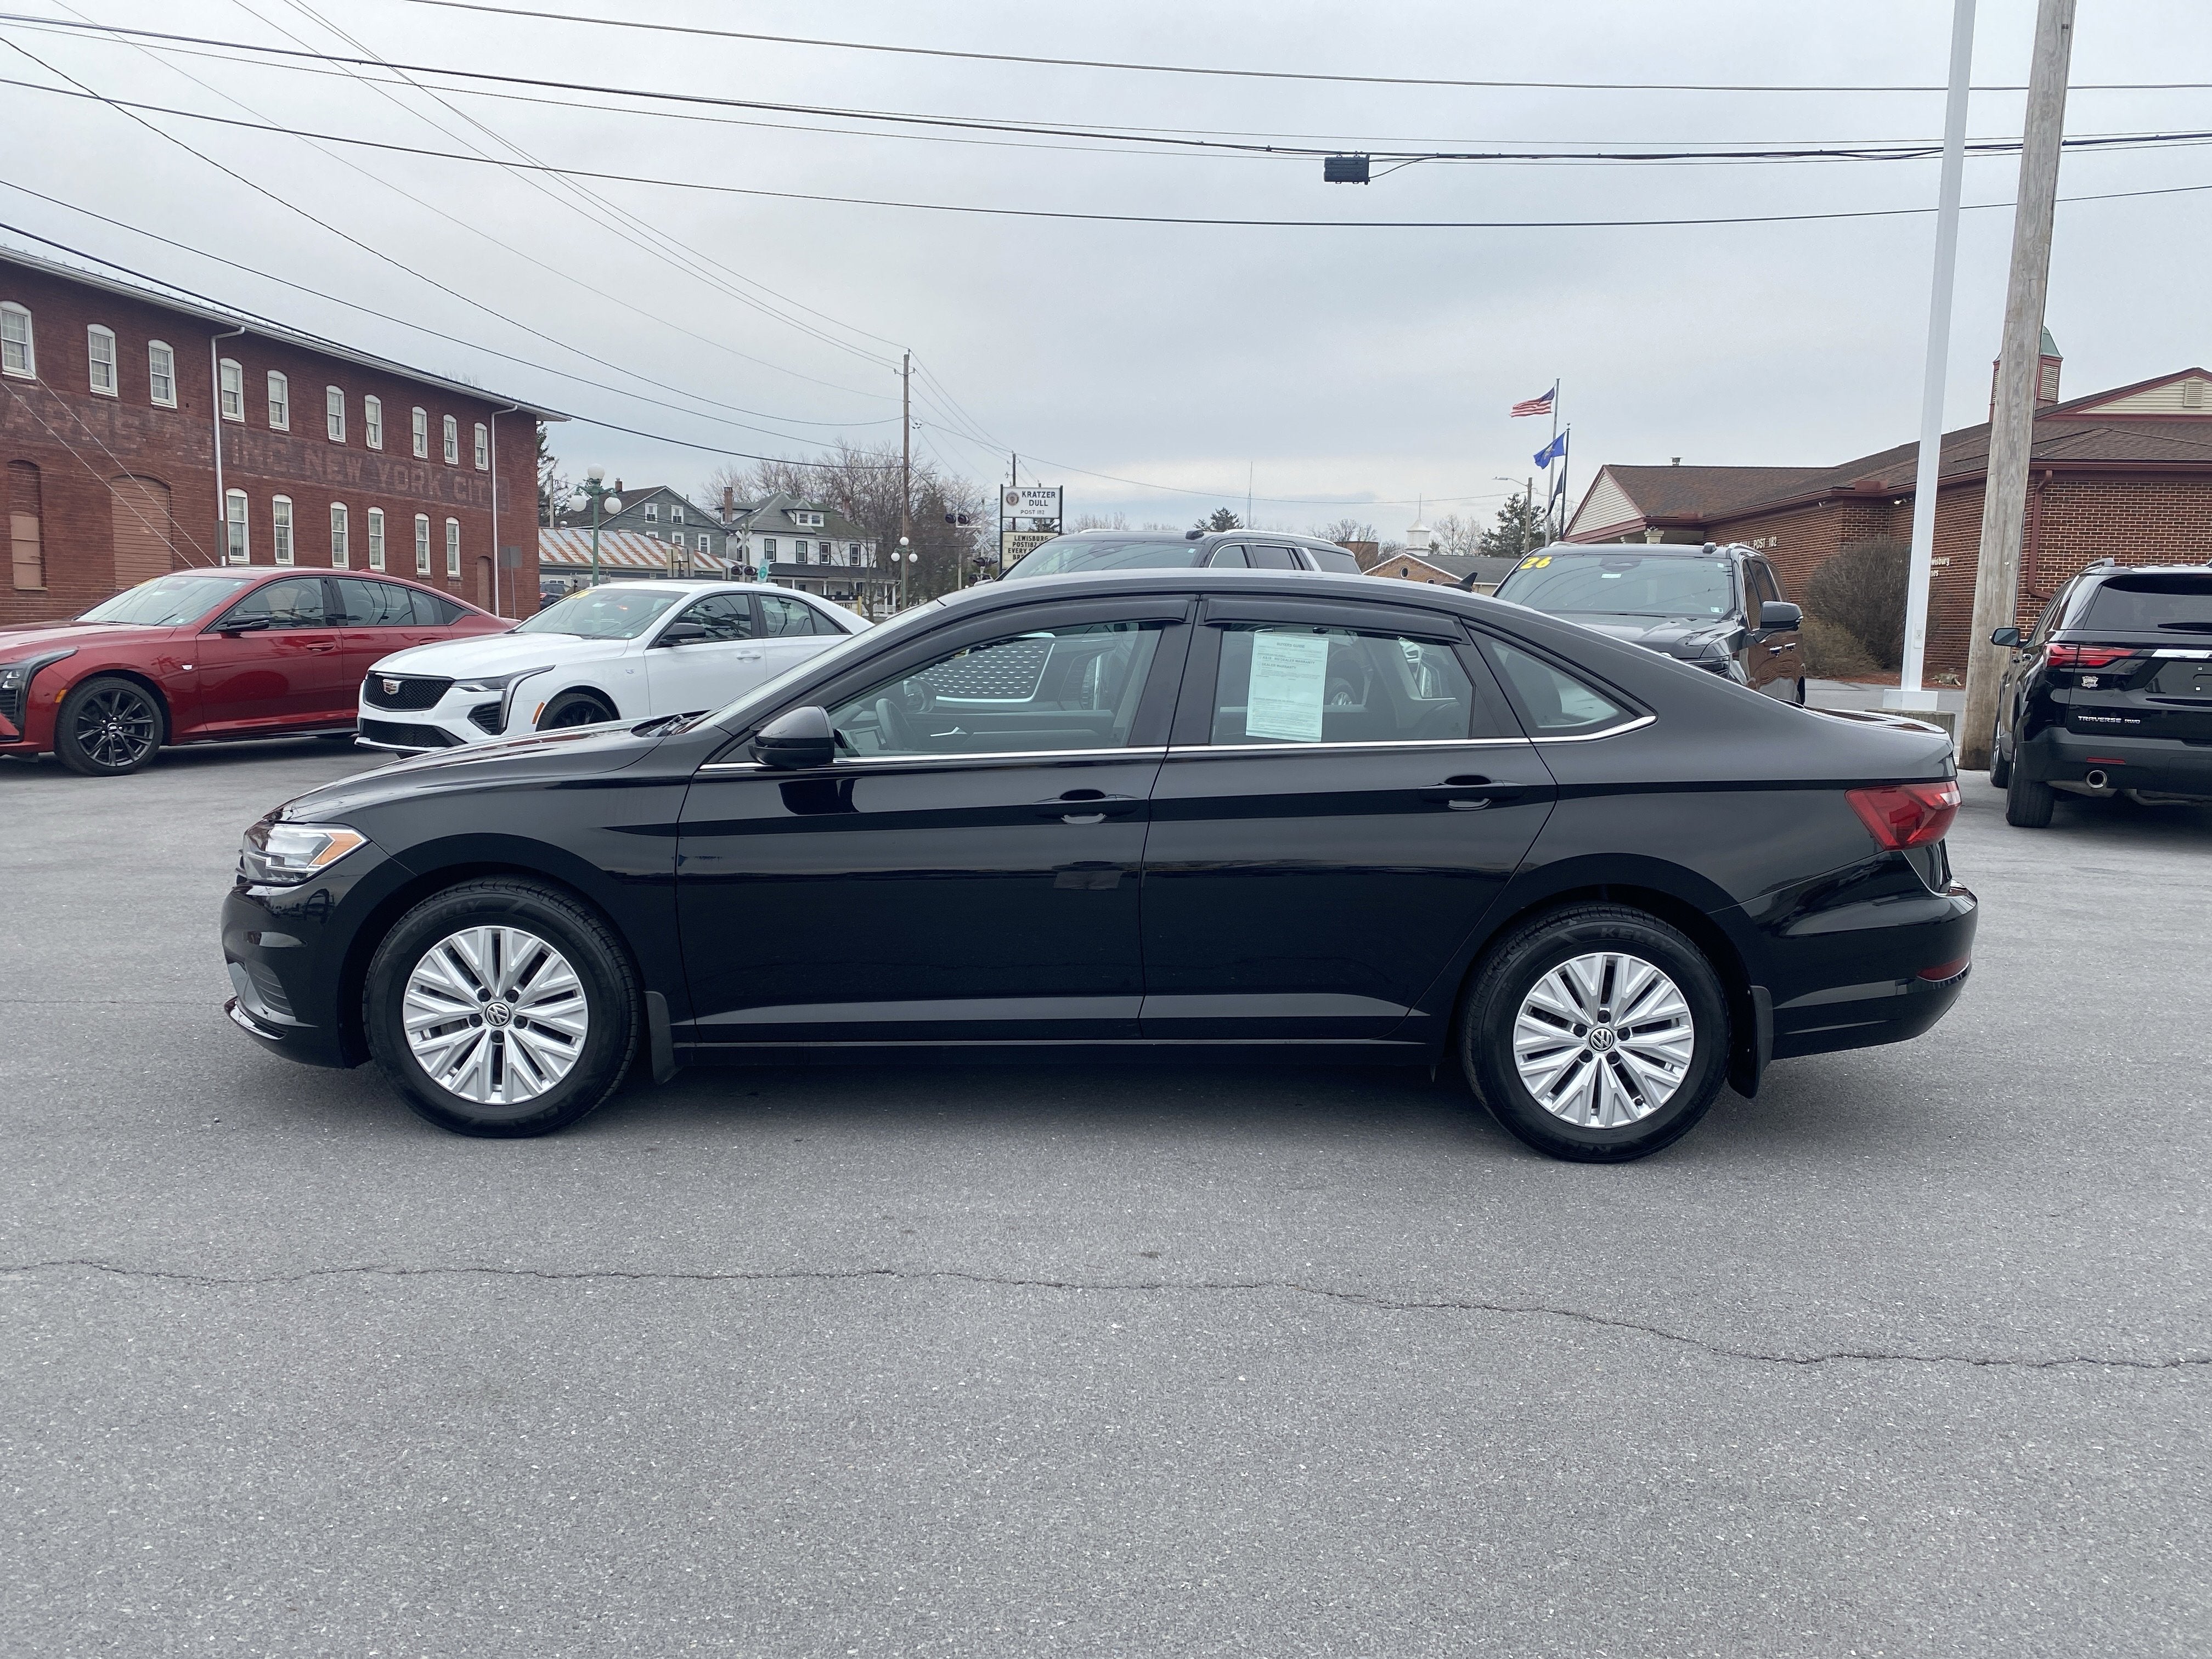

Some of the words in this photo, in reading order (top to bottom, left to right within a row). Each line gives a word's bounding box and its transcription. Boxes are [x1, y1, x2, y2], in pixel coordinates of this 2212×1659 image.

[303, 449, 362, 482] NEW
[377, 461, 442, 496] YORK
[1753, 538, 1765, 549] POST
[1769, 536, 1777, 547] 182
[1520, 556, 1553, 569] 26
